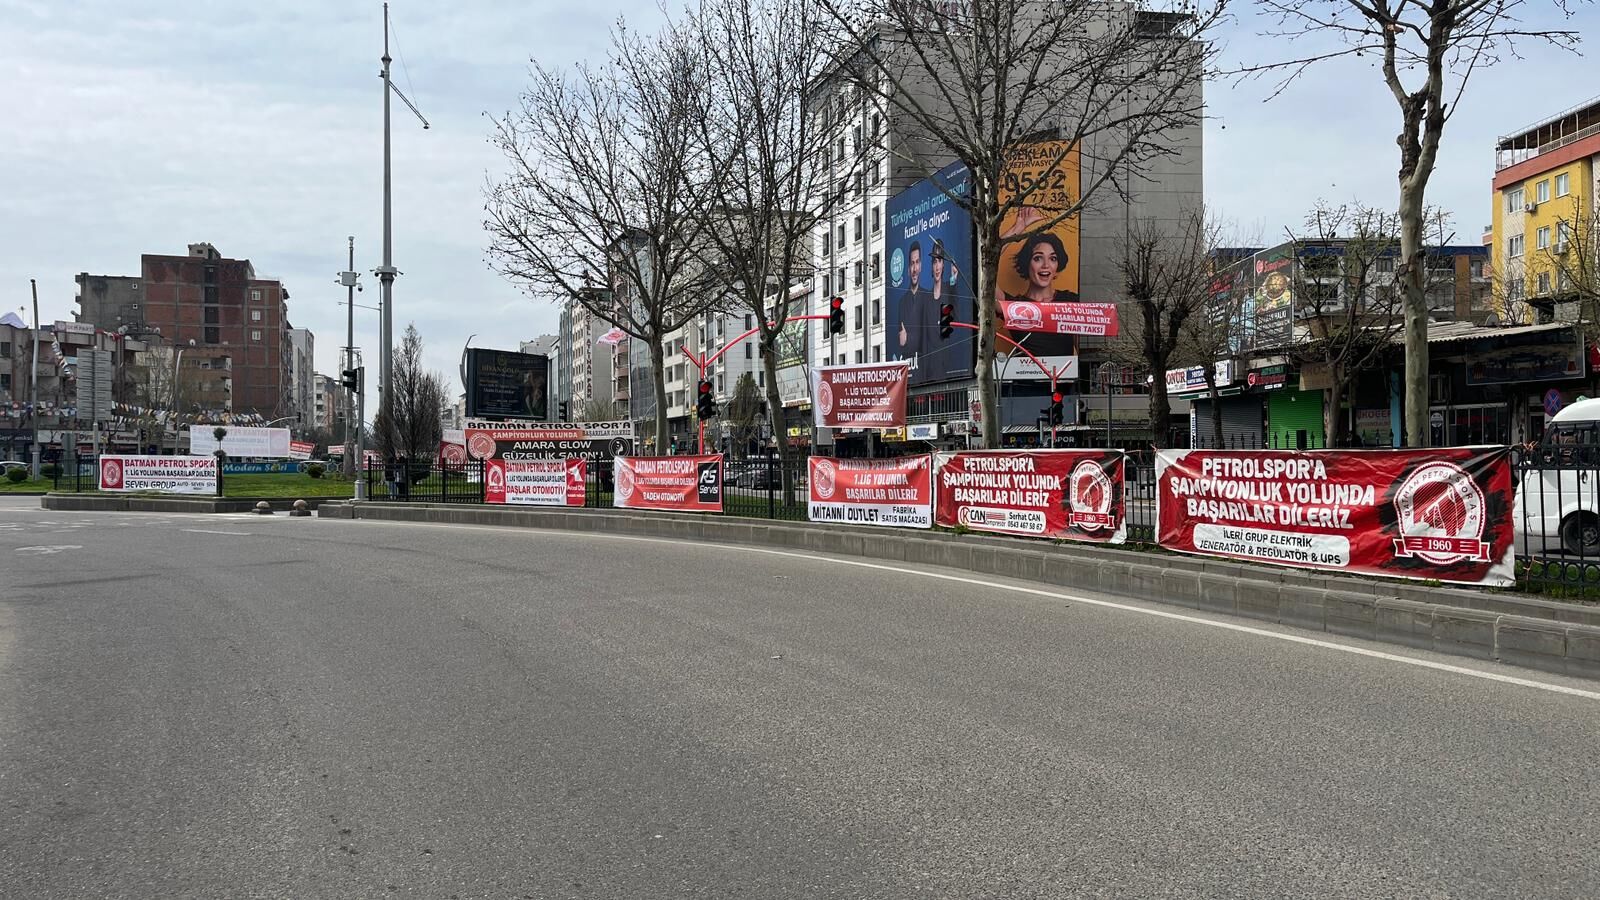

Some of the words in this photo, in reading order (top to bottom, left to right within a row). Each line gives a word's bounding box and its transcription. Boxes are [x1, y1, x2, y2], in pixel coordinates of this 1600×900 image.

[913, 196, 931, 217] evini
[832, 370, 856, 384] BATMAN
[859, 386, 888, 396] YOLUNDA
[837, 412, 854, 422] FIRAT
[467, 421, 528, 430] BATMAN
[530, 422, 580, 430] PETROL
[584, 420, 631, 430] SPOR'A
[545, 431, 578, 439] YOLUNDA
[513, 441, 556, 450] AMARA
[558, 440, 592, 449] GLOW
[125, 459, 157, 468] BATMAN
[158, 459, 188, 468] PETROL
[189, 459, 215, 469] SPOR'A
[222, 463, 262, 473] Modern
[505, 462, 526, 473] BATMAN
[526, 462, 546, 473] PETROL
[963, 456, 1035, 473] PETROLSPOR'A
[1202, 457, 1328, 481] PETROLSPOR'A
[140, 469, 166, 477] YOLUNDA
[700, 470, 717, 484] RS
[125, 480, 149, 489] SEVEN
[150, 480, 177, 489] GROUP
[873, 473, 909, 486] YOLUNDA
[943, 470, 1011, 490] ŞAMPİYONLUK
[1011, 474, 1062, 491] YOLUNDA
[506, 485, 531, 495] DAŞLAR
[532, 484, 565, 495] OTOMOTİV
[699, 485, 719, 495] Servis
[846, 487, 887, 503] BAŞARILAR
[888, 485, 918, 501] DİLERİZ
[1170, 476, 1284, 502] ŞAMPİYONLUK
[1286, 482, 1375, 507] YOLUNDA
[954, 488, 1008, 506] BAŞARILAR
[1009, 489, 1050, 508] DİLERİZ
[812, 503, 846, 521] MİTANNİ
[847, 508, 879, 522] OUTLET
[892, 505, 917, 515] FABRİKA
[1008, 511, 1027, 521] Serhat
[1027, 512, 1041, 522] CAN
[1186, 499, 1276, 523] BAŞARILAR
[1279, 503, 1354, 530] DİLERİZ
[1223, 527, 1243, 540] İLERİ
[1244, 532, 1268, 544] GRUP
[1269, 533, 1313, 548] ELEKTRİK
[1428, 540, 1452, 551] 1960
[1200, 539, 1247, 555] JENERATÖR
[1247, 546, 1255, 555] &
[1255, 546, 1308, 562] REGÜLATÖR
[1310, 552, 1319, 562] &
[1320, 552, 1341, 565] UPS
